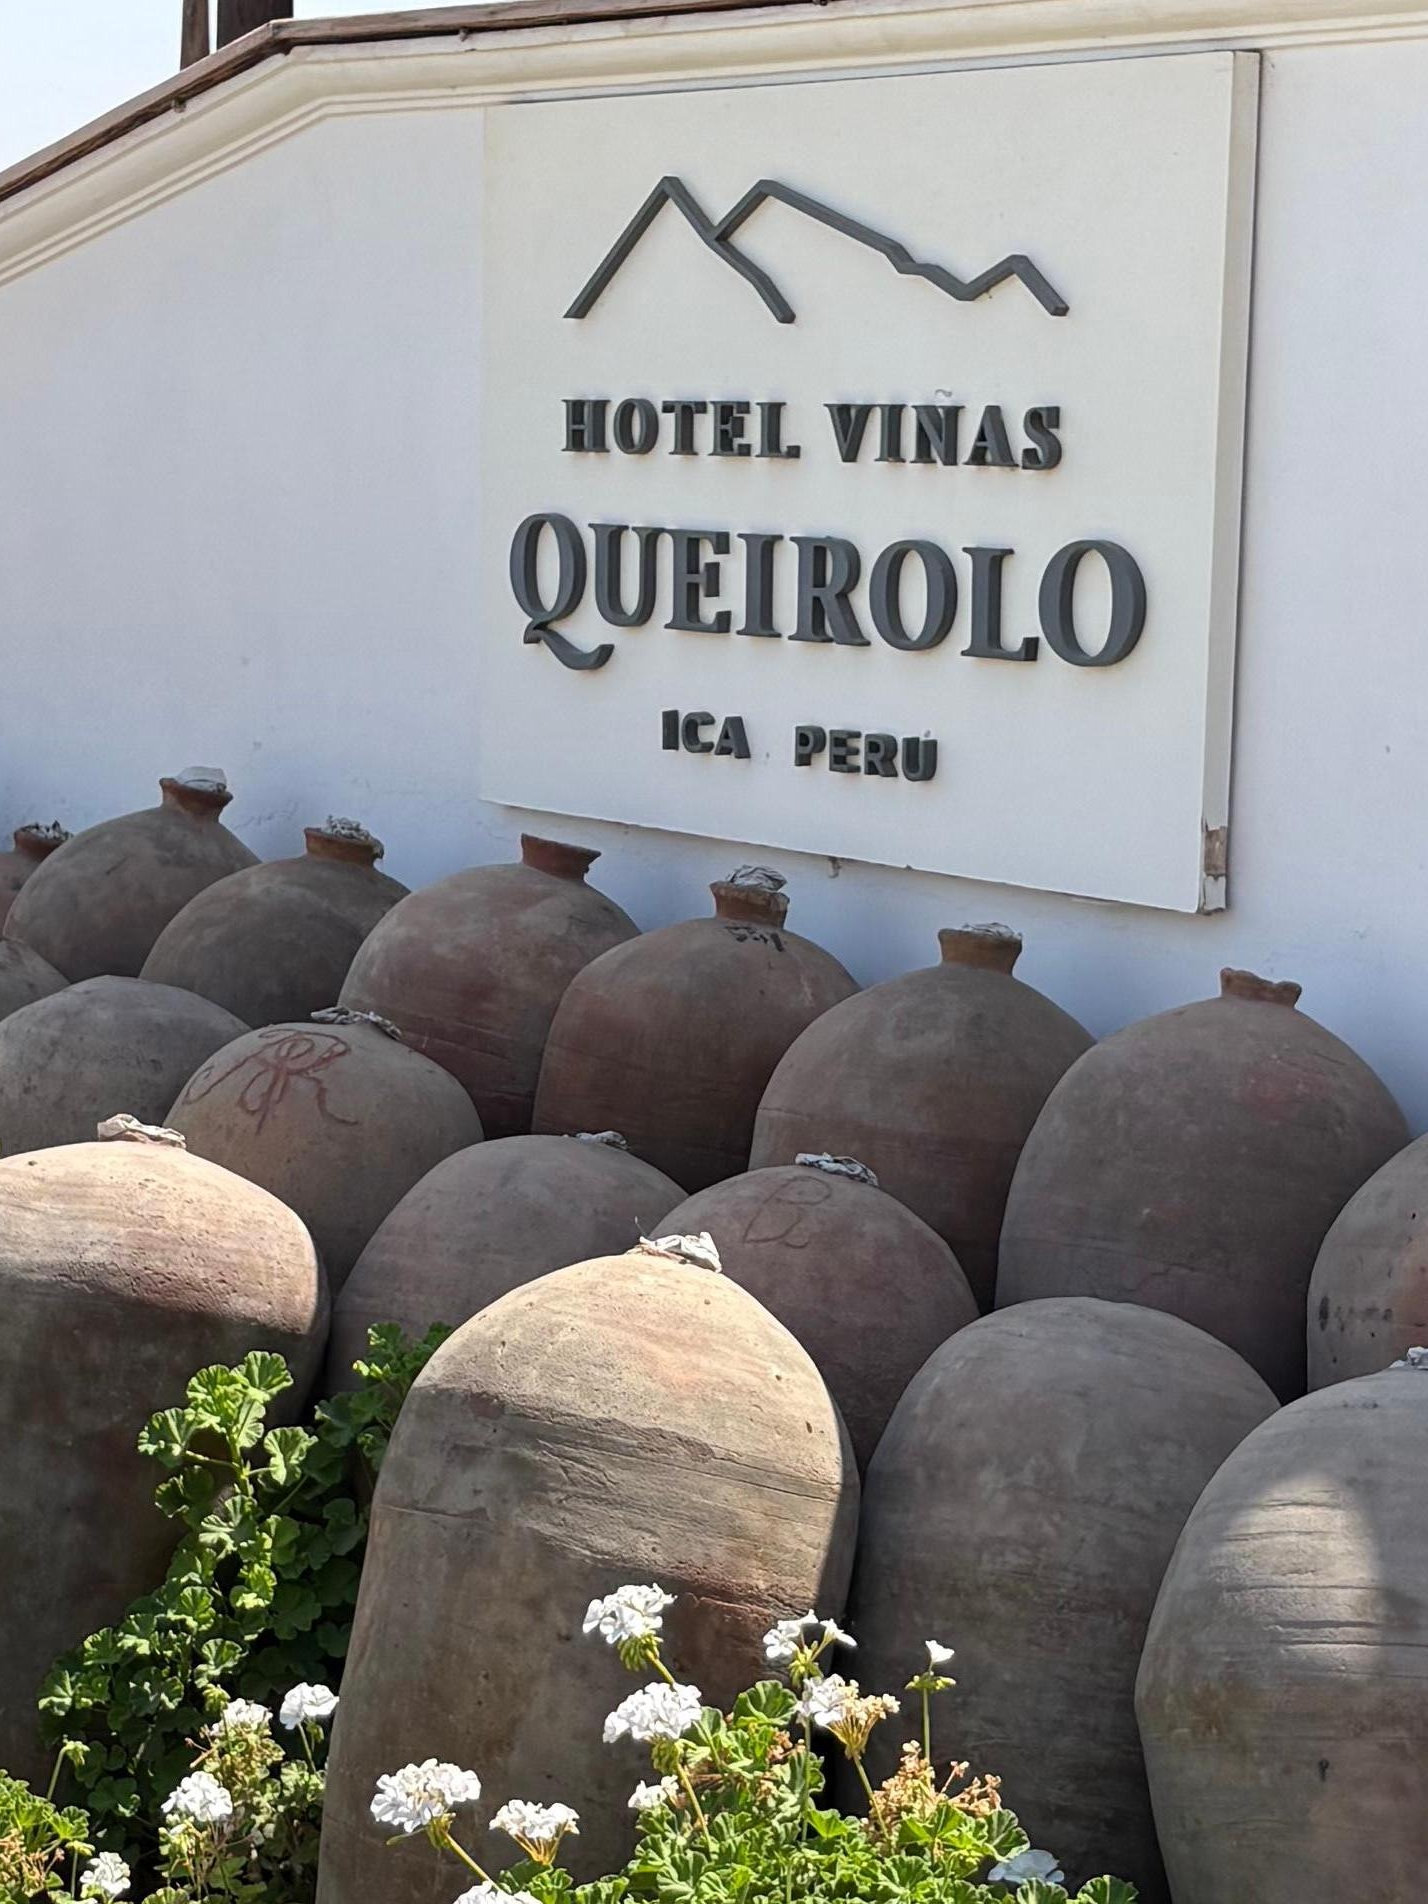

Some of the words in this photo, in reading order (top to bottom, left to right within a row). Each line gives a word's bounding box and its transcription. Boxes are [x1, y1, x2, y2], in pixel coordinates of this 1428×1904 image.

[561, 398, 801, 458] HOTEL
[509, 512, 1148, 670] QUEIROLO
[662, 710, 751, 759] ICA
